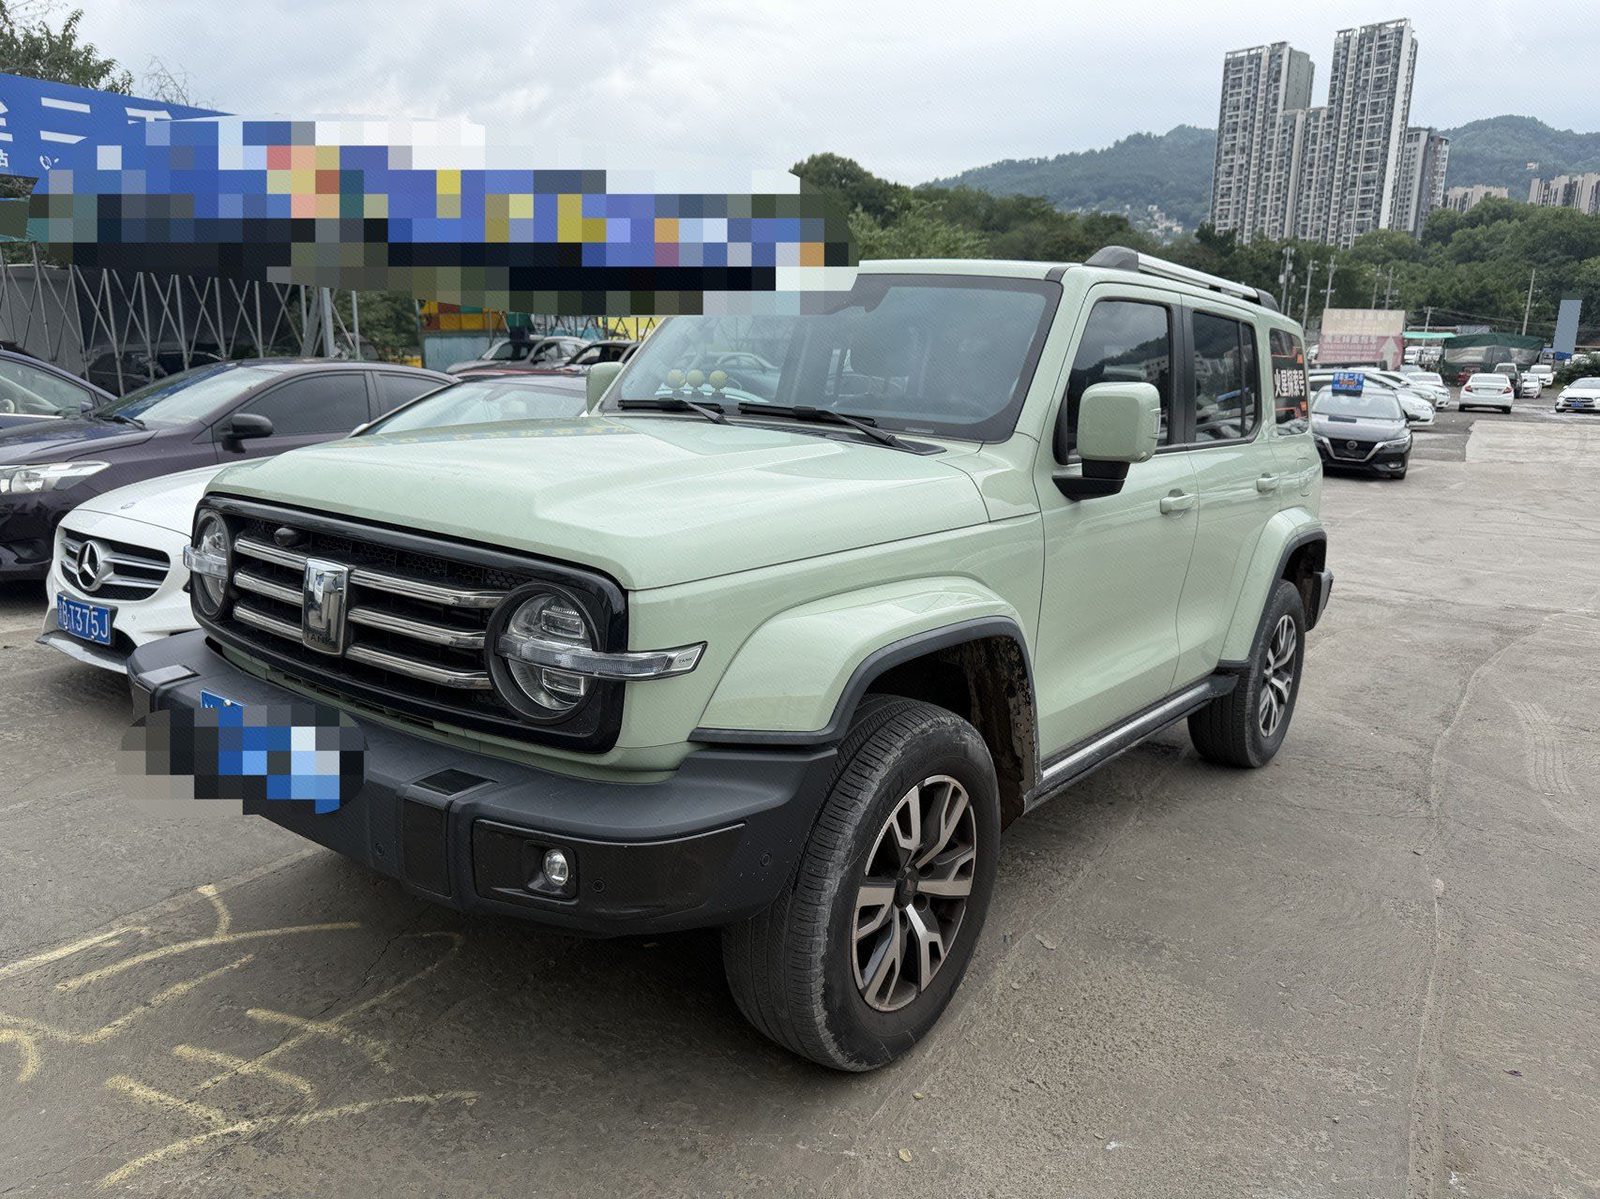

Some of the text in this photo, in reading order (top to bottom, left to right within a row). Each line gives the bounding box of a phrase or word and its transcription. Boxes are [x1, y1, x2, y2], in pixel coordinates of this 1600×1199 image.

[1274, 368, 1305, 397] 火星探索号
